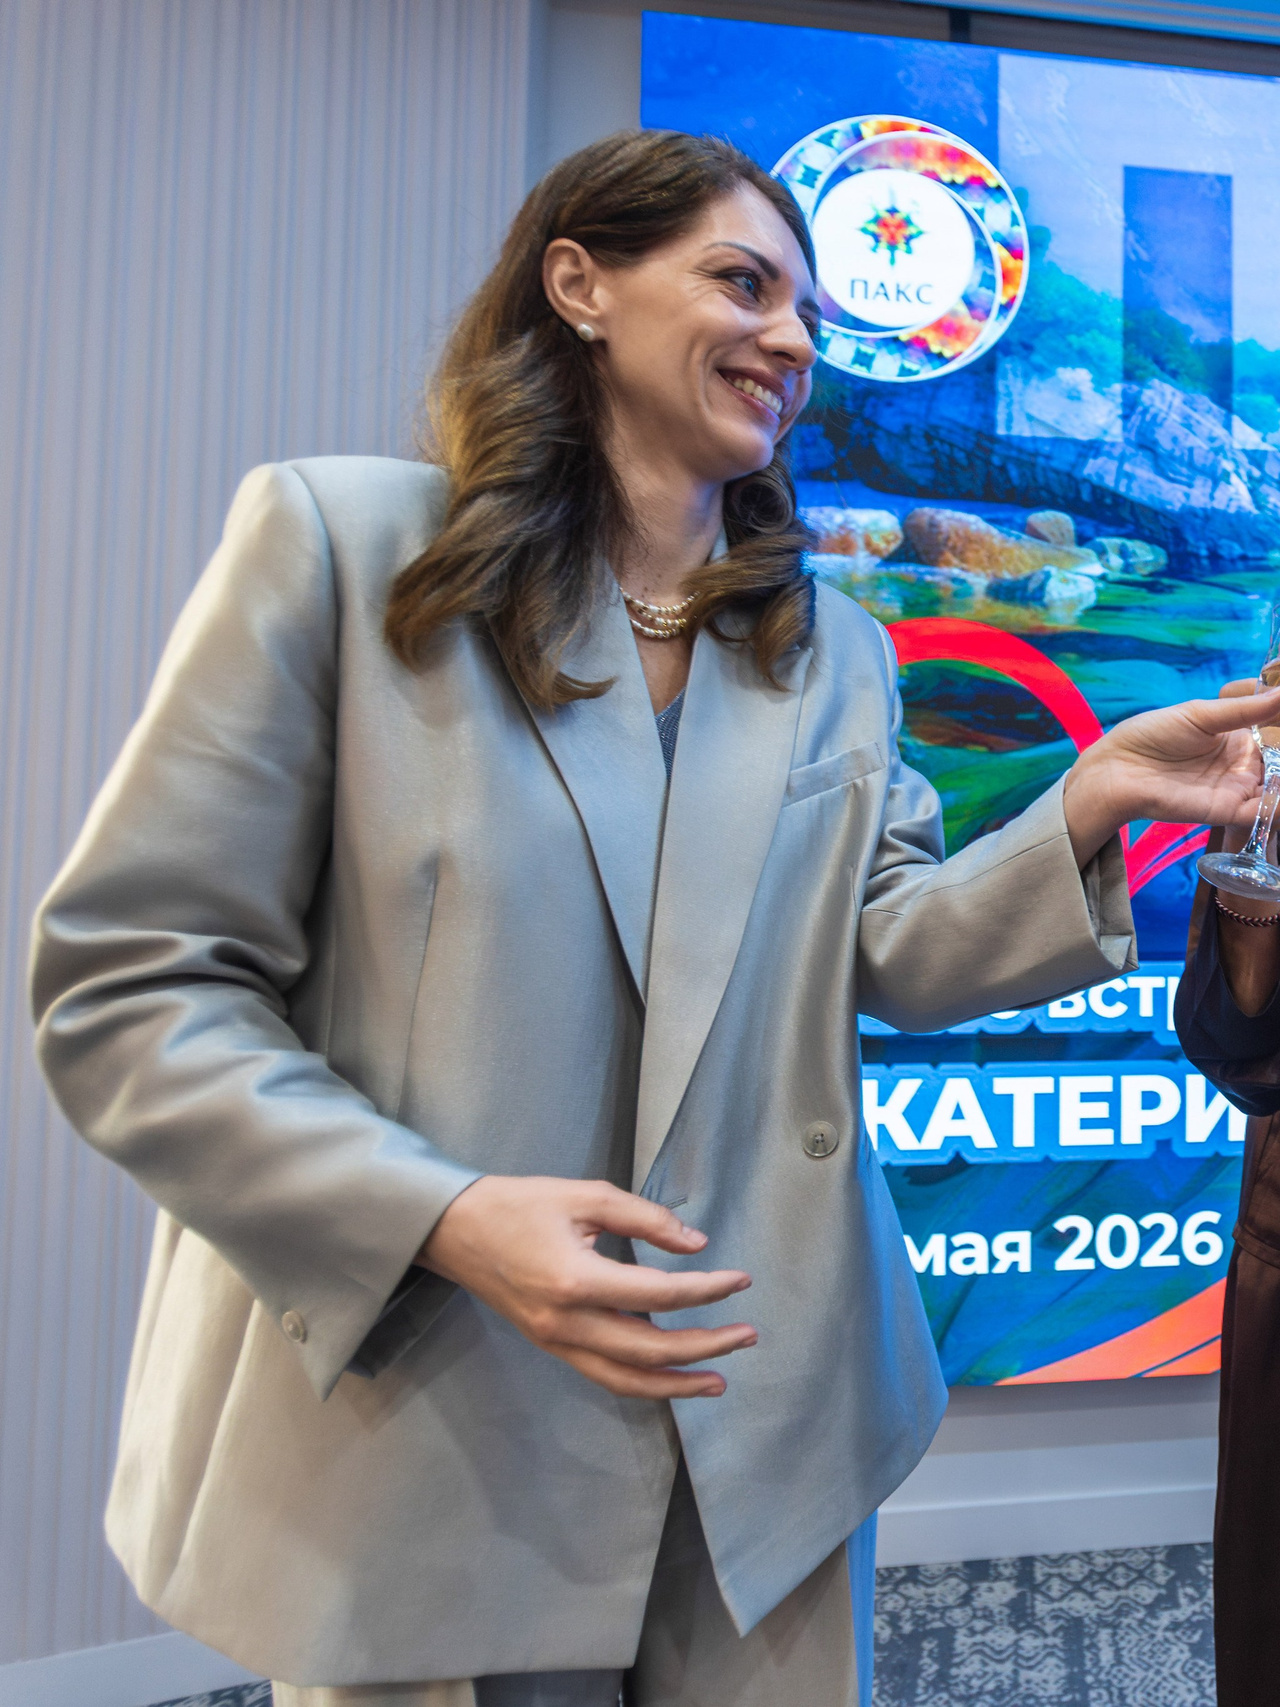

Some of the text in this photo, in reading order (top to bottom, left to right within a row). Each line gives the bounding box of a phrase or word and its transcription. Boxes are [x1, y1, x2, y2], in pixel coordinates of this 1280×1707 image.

[850, 279, 934, 305] ПАКС
[903, 1211, 1224, 1276] мая 2026
